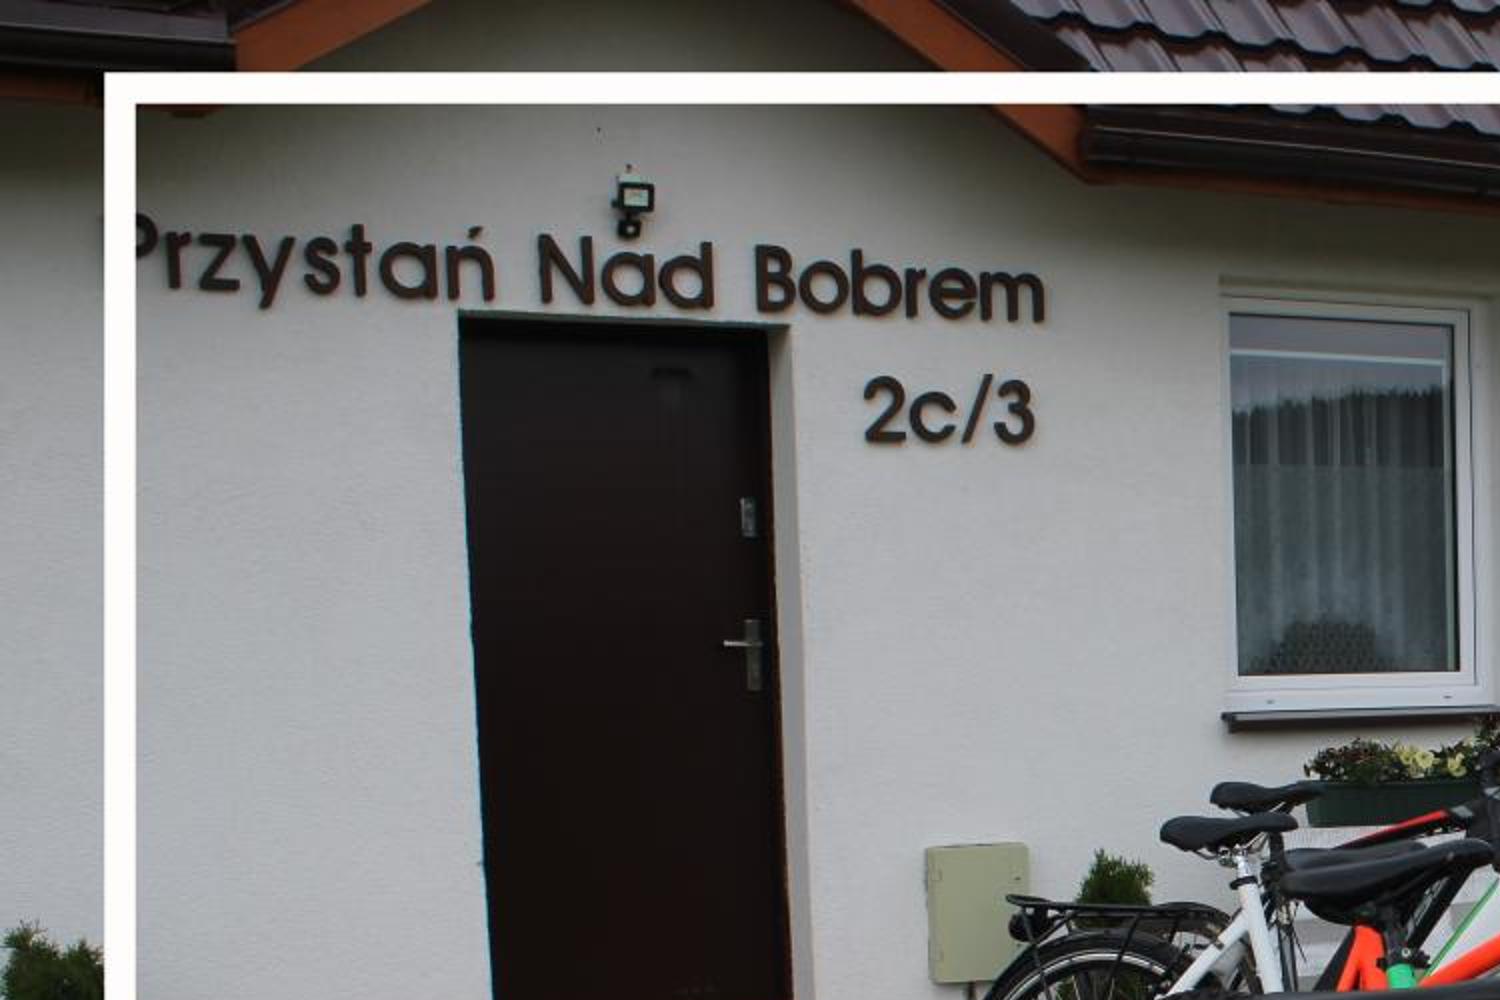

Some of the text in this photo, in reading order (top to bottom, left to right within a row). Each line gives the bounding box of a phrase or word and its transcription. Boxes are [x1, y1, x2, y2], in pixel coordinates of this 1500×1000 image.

[537, 233, 715, 311] Nad
[754, 244, 1046, 324] Bobrem
[863, 373, 1035, 446] 2c/3
